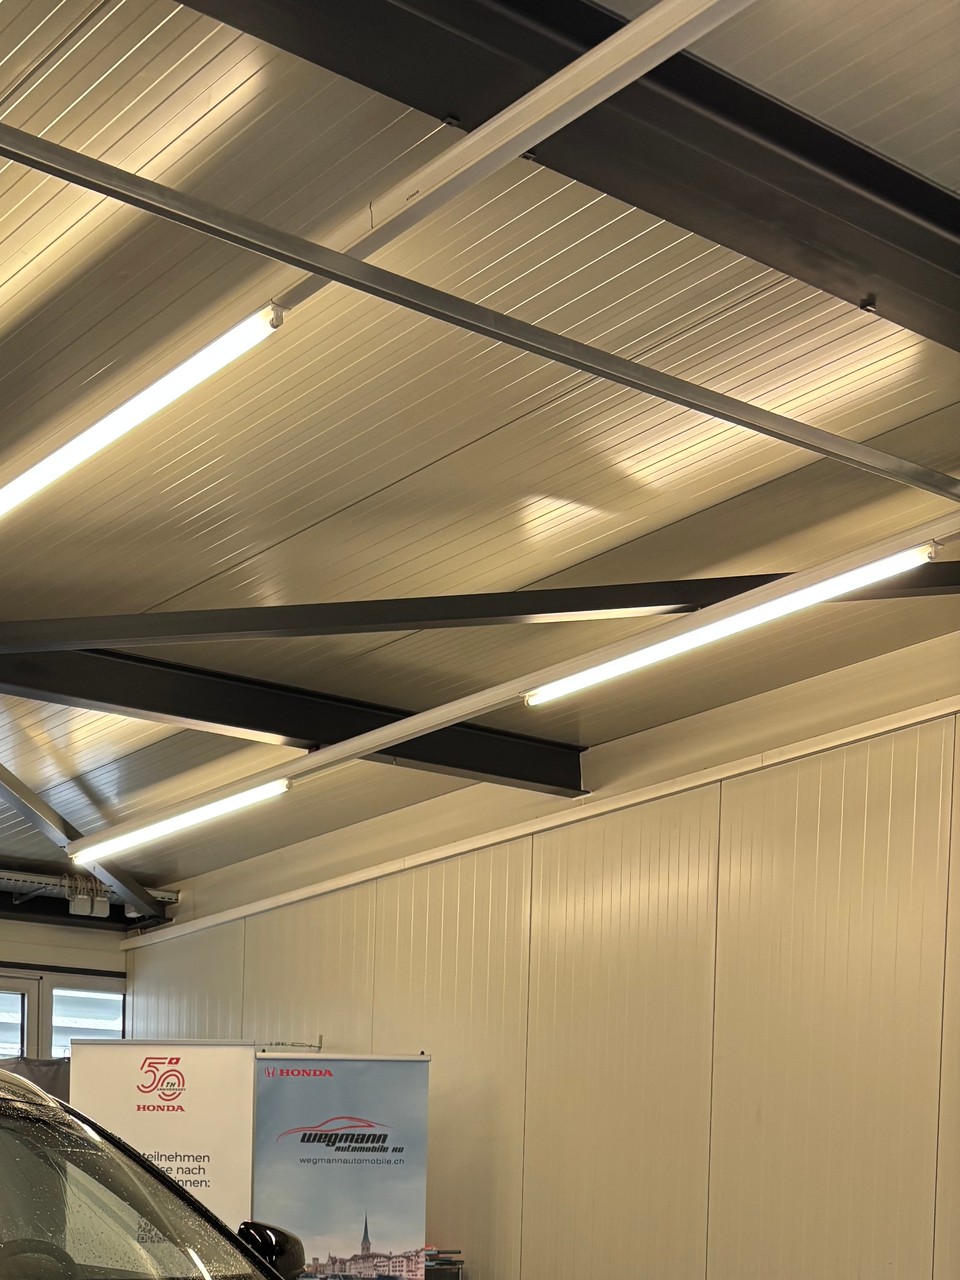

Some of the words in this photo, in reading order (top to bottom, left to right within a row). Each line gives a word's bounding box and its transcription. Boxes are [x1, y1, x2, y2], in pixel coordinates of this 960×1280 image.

[279, 1068, 334, 1078] HONDA
[136, 1104, 185, 1113] HONDA
[299, 1132, 389, 1147] wegmann
[299, 1156, 406, 1166] wegmannautomobile.ch
[176, 1165, 206, 1175] nach
